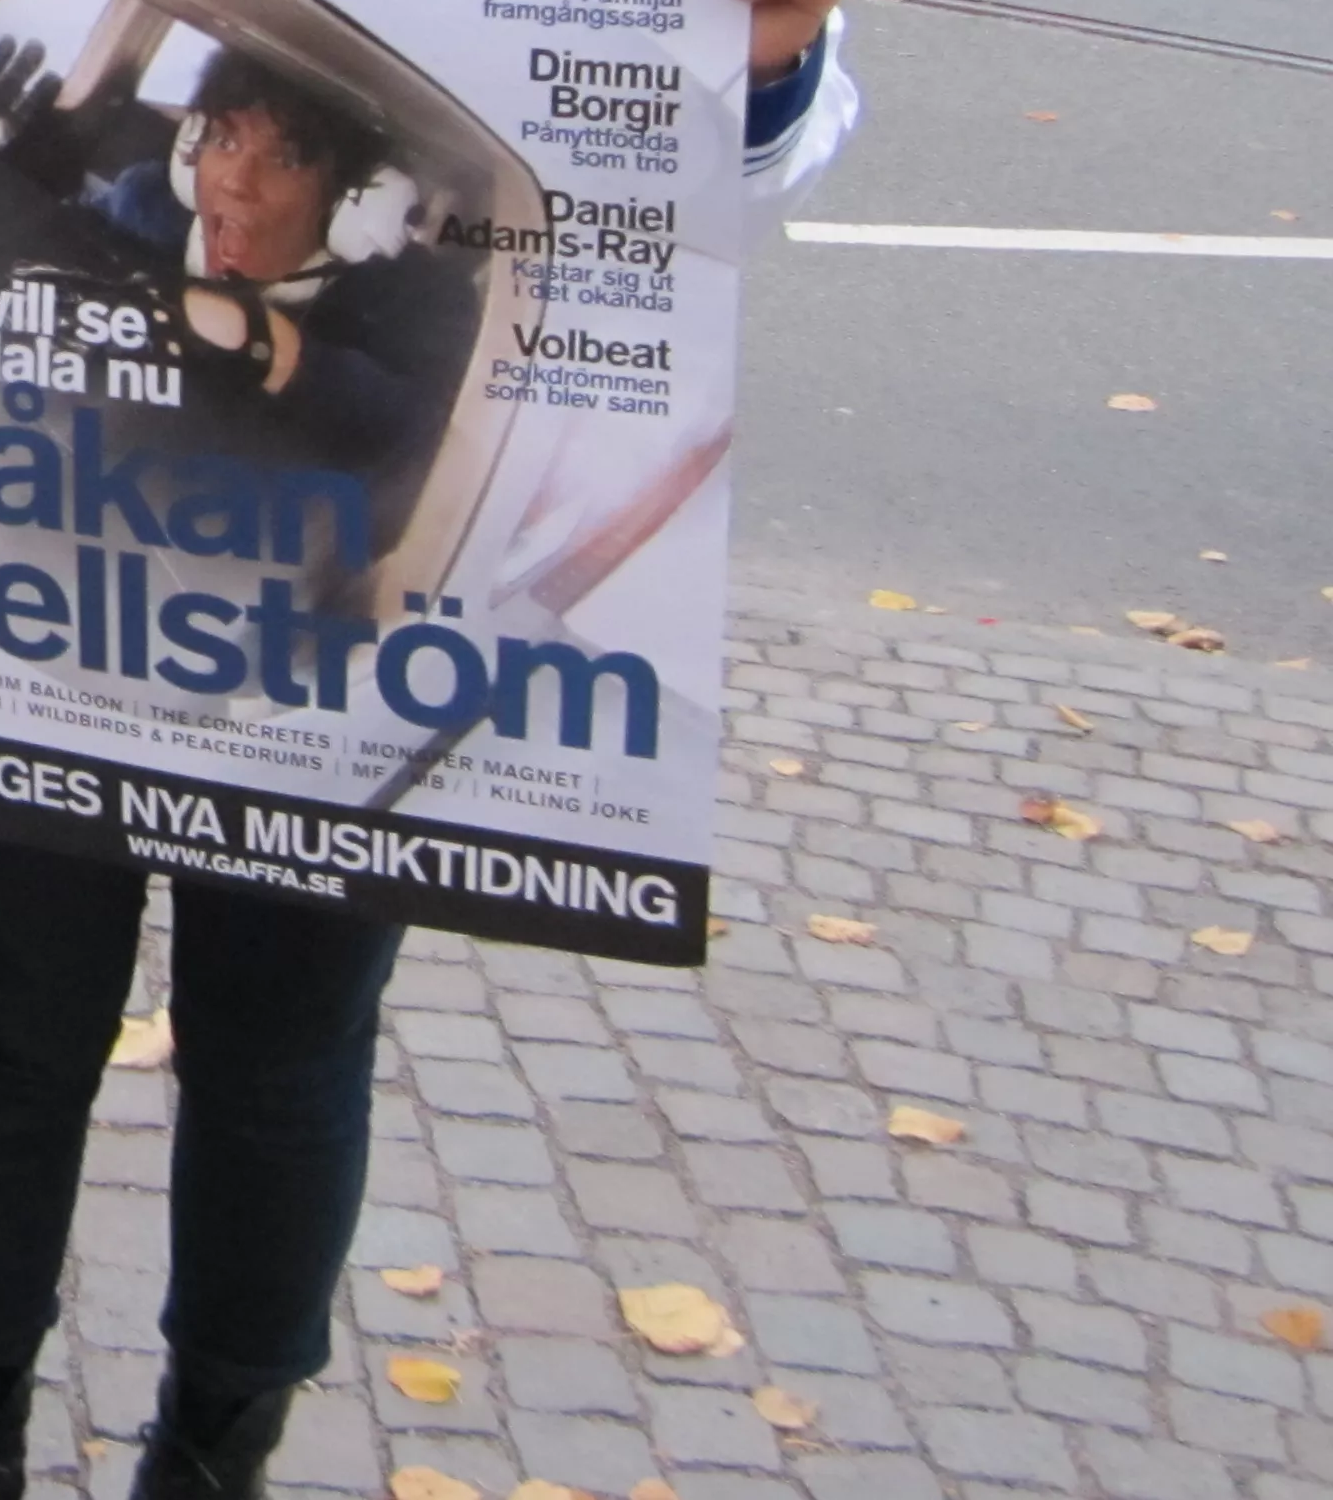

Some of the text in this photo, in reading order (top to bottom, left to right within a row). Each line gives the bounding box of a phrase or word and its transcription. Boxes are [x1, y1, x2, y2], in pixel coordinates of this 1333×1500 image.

[529, 47, 681, 92] Dimmu
[550, 85, 682, 132] Borgir
[521, 120, 679, 153] Pånyttfödda
[570, 150, 679, 175] som trio
[542, 188, 675, 233] Daniel
[436, 213, 676, 275] Adams-Ray
[511, 257, 674, 293] Kastar sig ut
[528, 279, 674, 313] det okända
[74, 301, 148, 349] se
[511, 322, 672, 372] Volbeat
[107, 358, 182, 407] nu
[484, 382, 670, 418] som blev sann
[491, 359, 670, 396] Pojkdrömmen
[29, 680, 124, 713] BALLOON
[149, 704, 190, 726] THE
[197, 712, 331, 750] CONCRETES
[482, 758, 582, 790] MAGNET
[27, 703, 141, 738] WILDBIRDS
[150, 726, 164, 743] &
[170, 731, 324, 771] PEACEDRUMS
[490, 784, 581, 814] KILLING
[589, 800, 651, 826] JOKE
[120, 779, 228, 845] NYA
[243, 805, 678, 928] MUSIKTIDNING
[126, 833, 347, 900] WWW.GAFFA.SE
